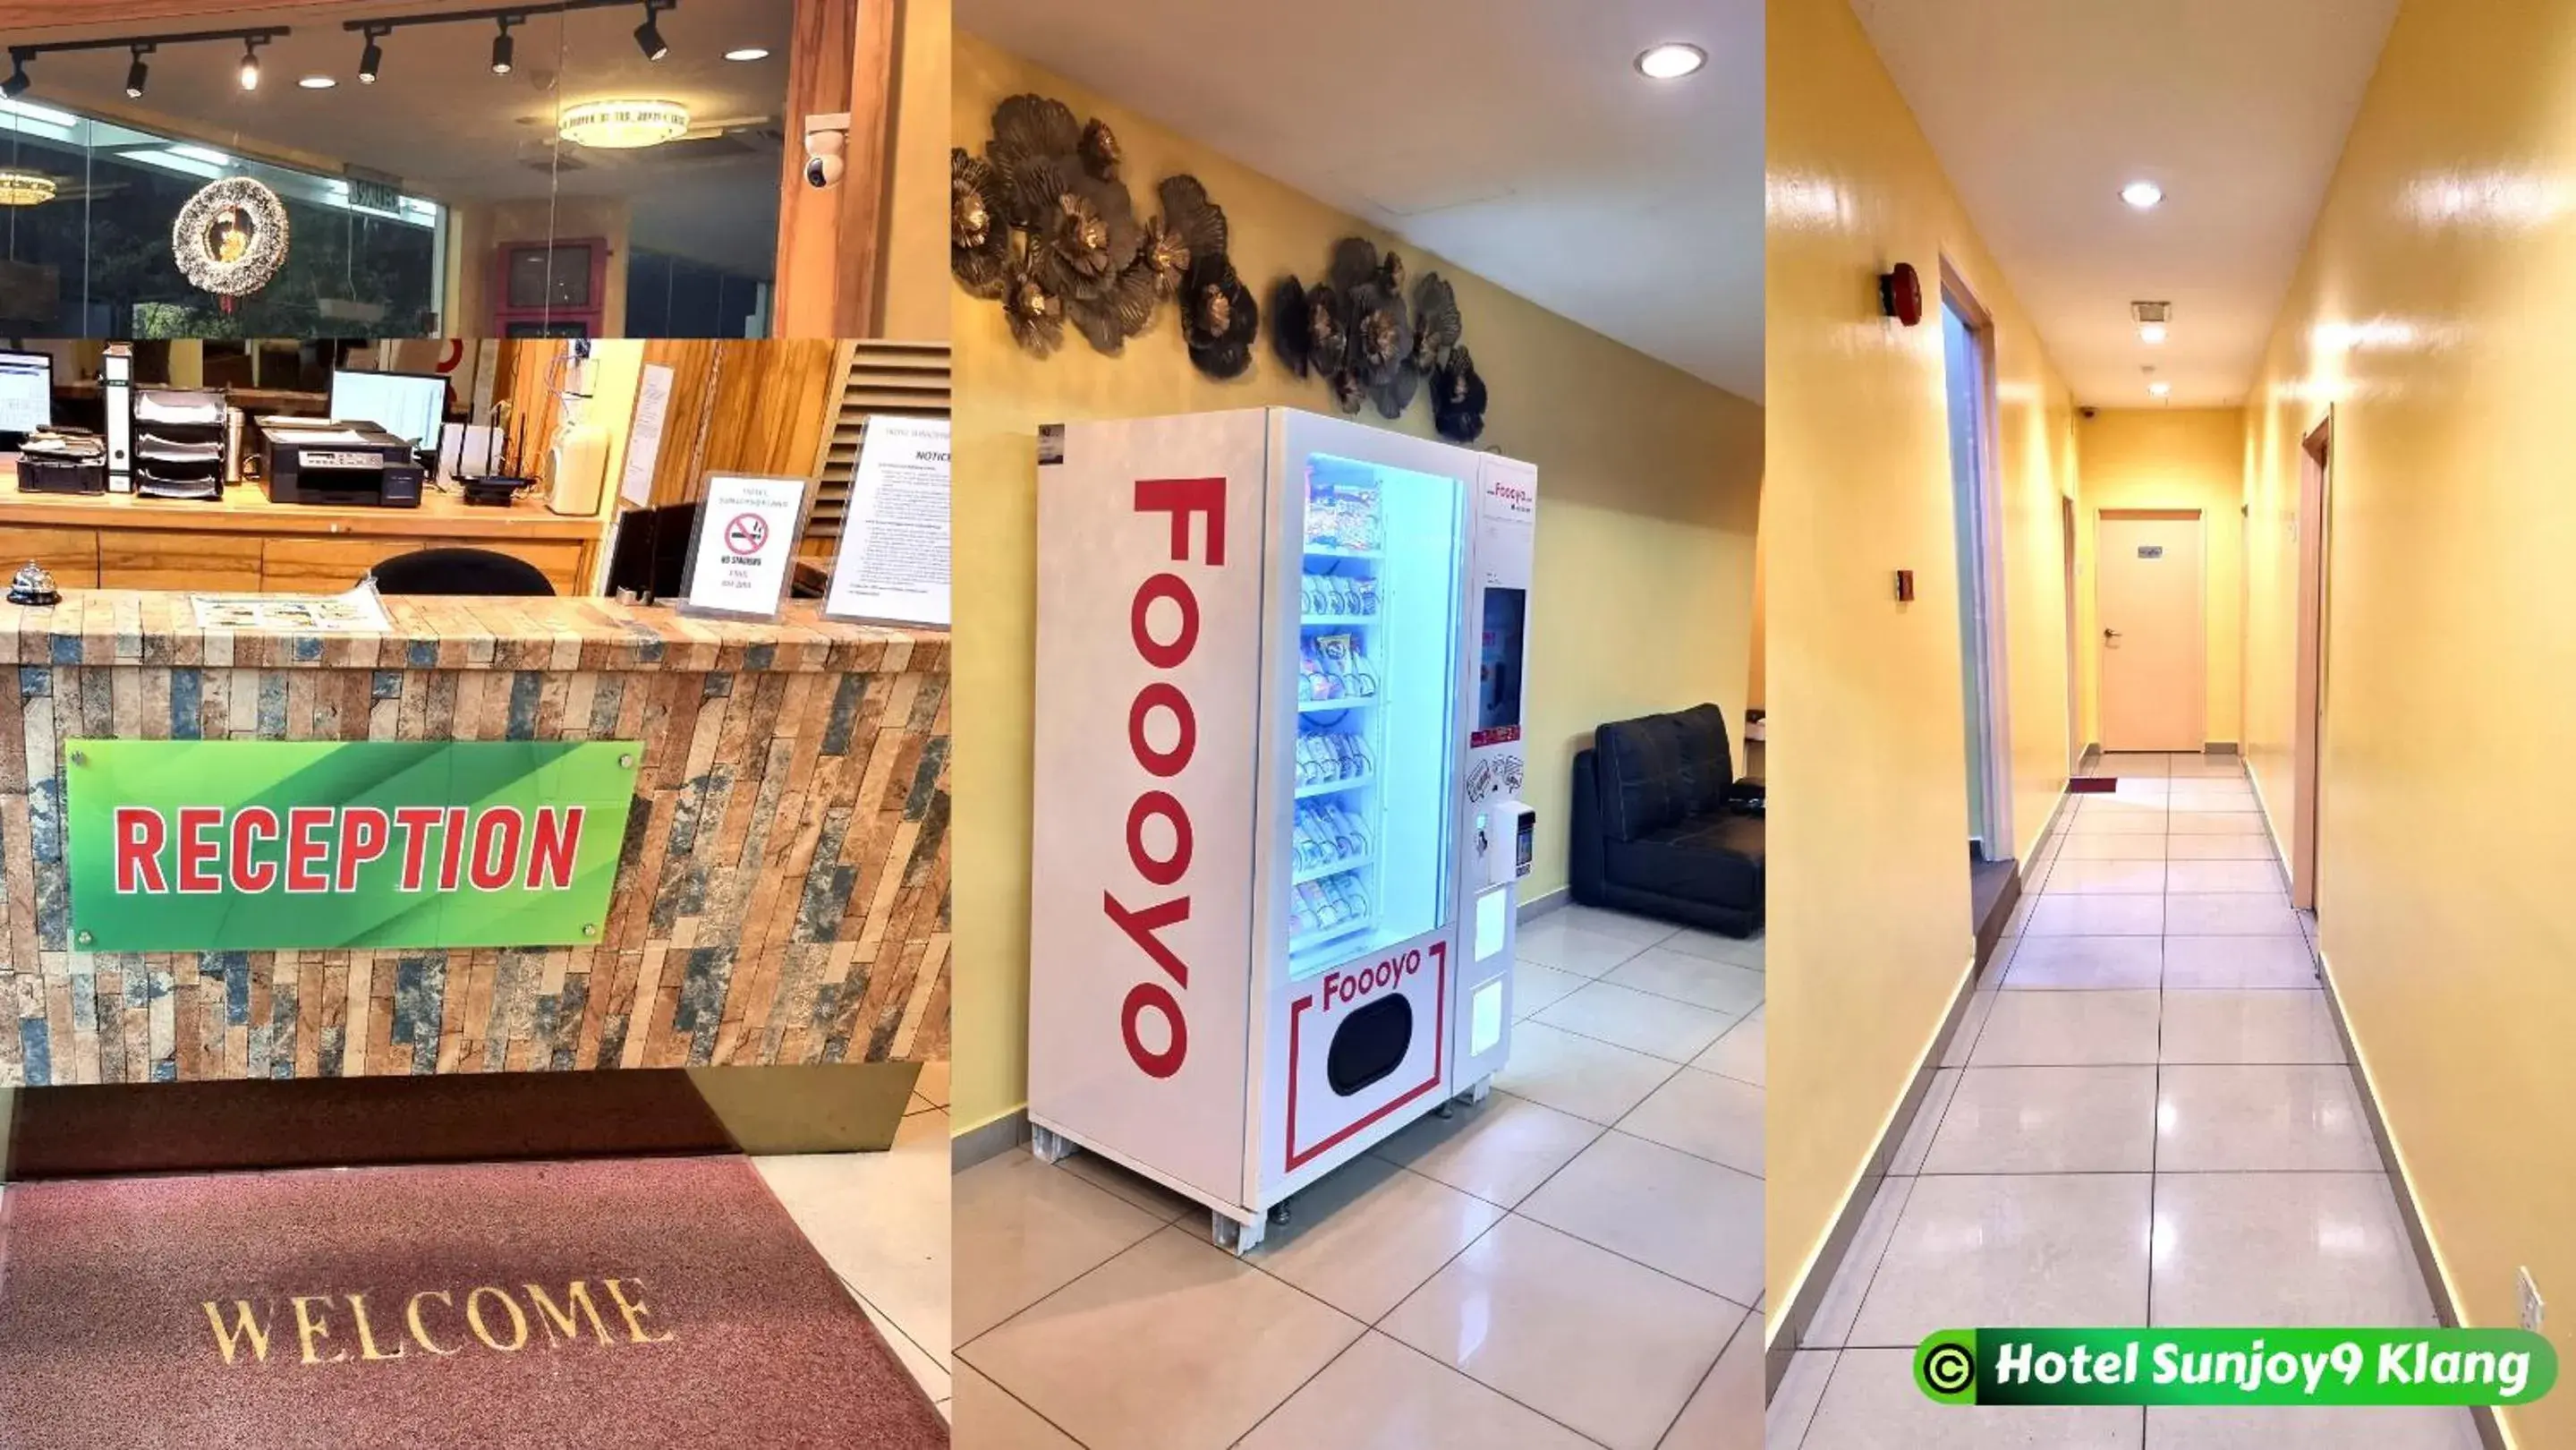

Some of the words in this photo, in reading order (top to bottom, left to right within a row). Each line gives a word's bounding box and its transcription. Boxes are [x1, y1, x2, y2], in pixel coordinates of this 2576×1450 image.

[1106, 477, 1227, 1078] Foooyo
[115, 806, 587, 893] RECEPTION
[1323, 949, 1421, 1012] Foooyo
[202, 1277, 676, 1366] WELCOME
